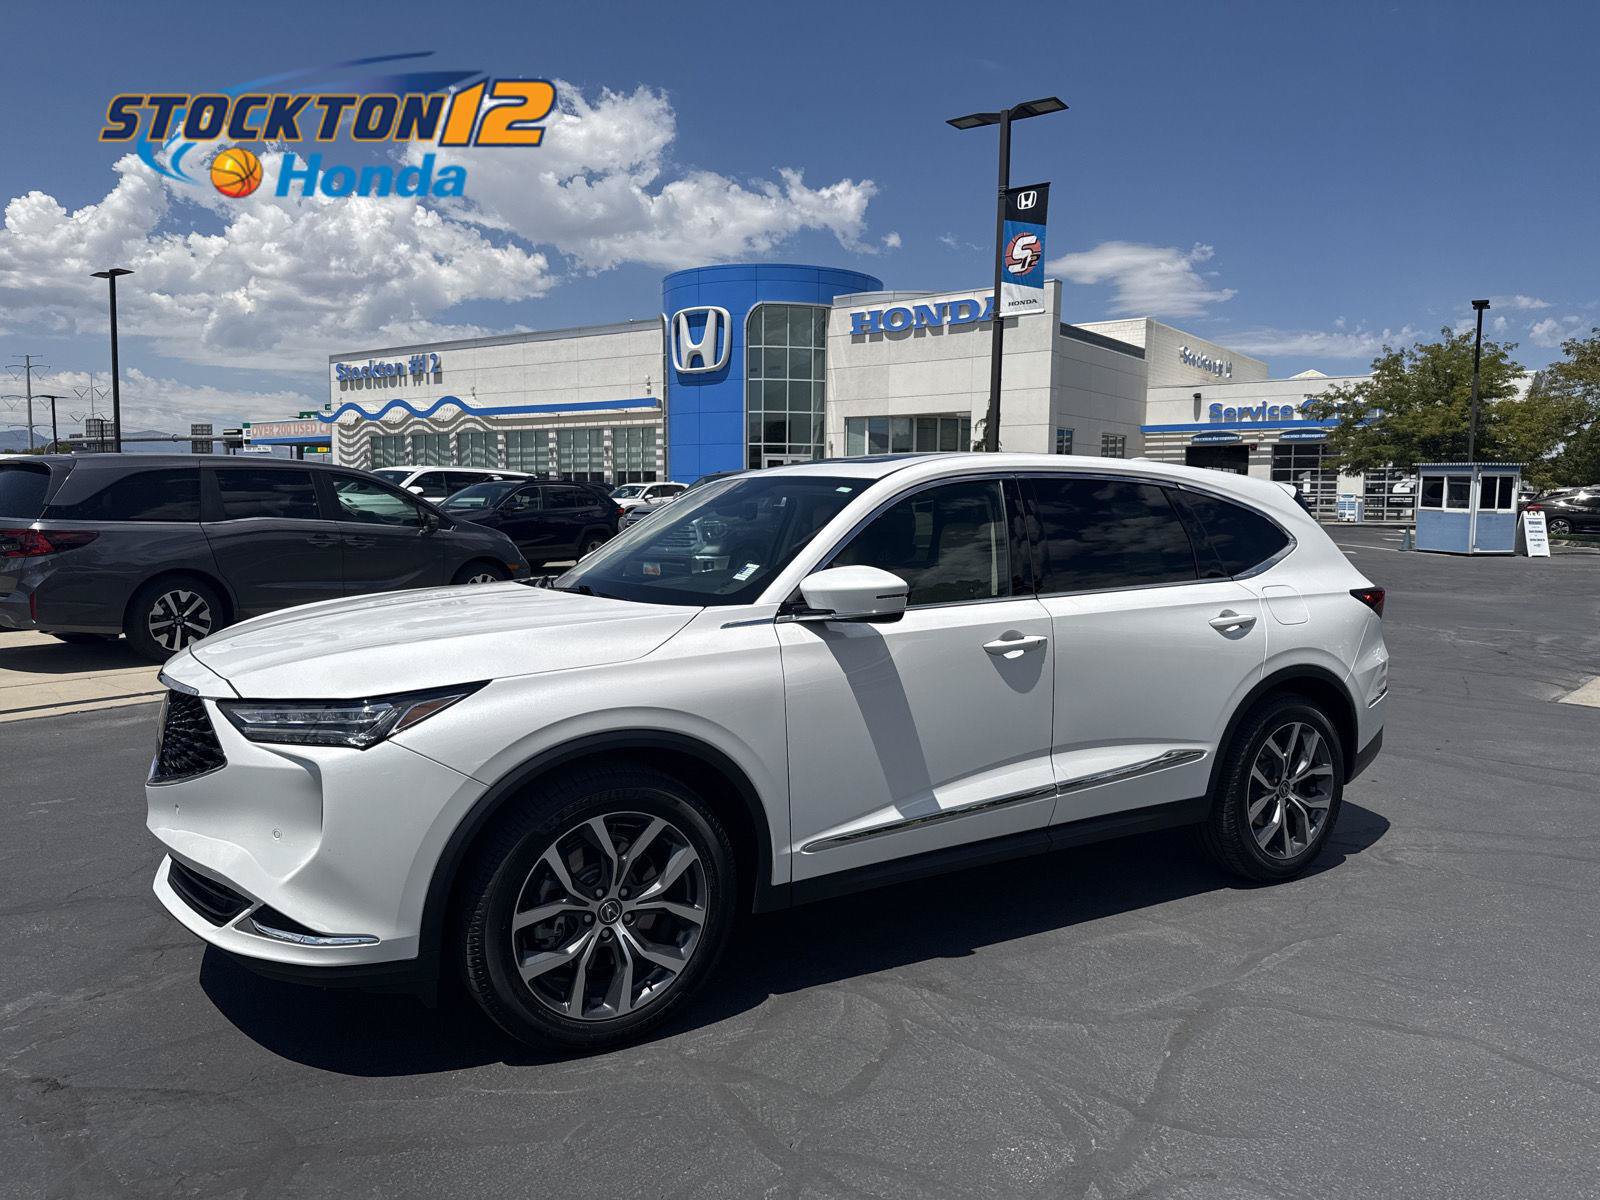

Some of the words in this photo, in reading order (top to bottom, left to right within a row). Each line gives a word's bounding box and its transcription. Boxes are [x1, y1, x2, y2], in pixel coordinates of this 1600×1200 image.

[1008, 298, 1038, 307] HONDA
[335, 360, 405, 381] Stockton
[1209, 401, 1294, 419] Service
[252, 423, 274, 437] OVER
[275, 423, 292, 436] 200
[293, 422, 317, 435] USED
[1298, 470, 1311, 494] 1
